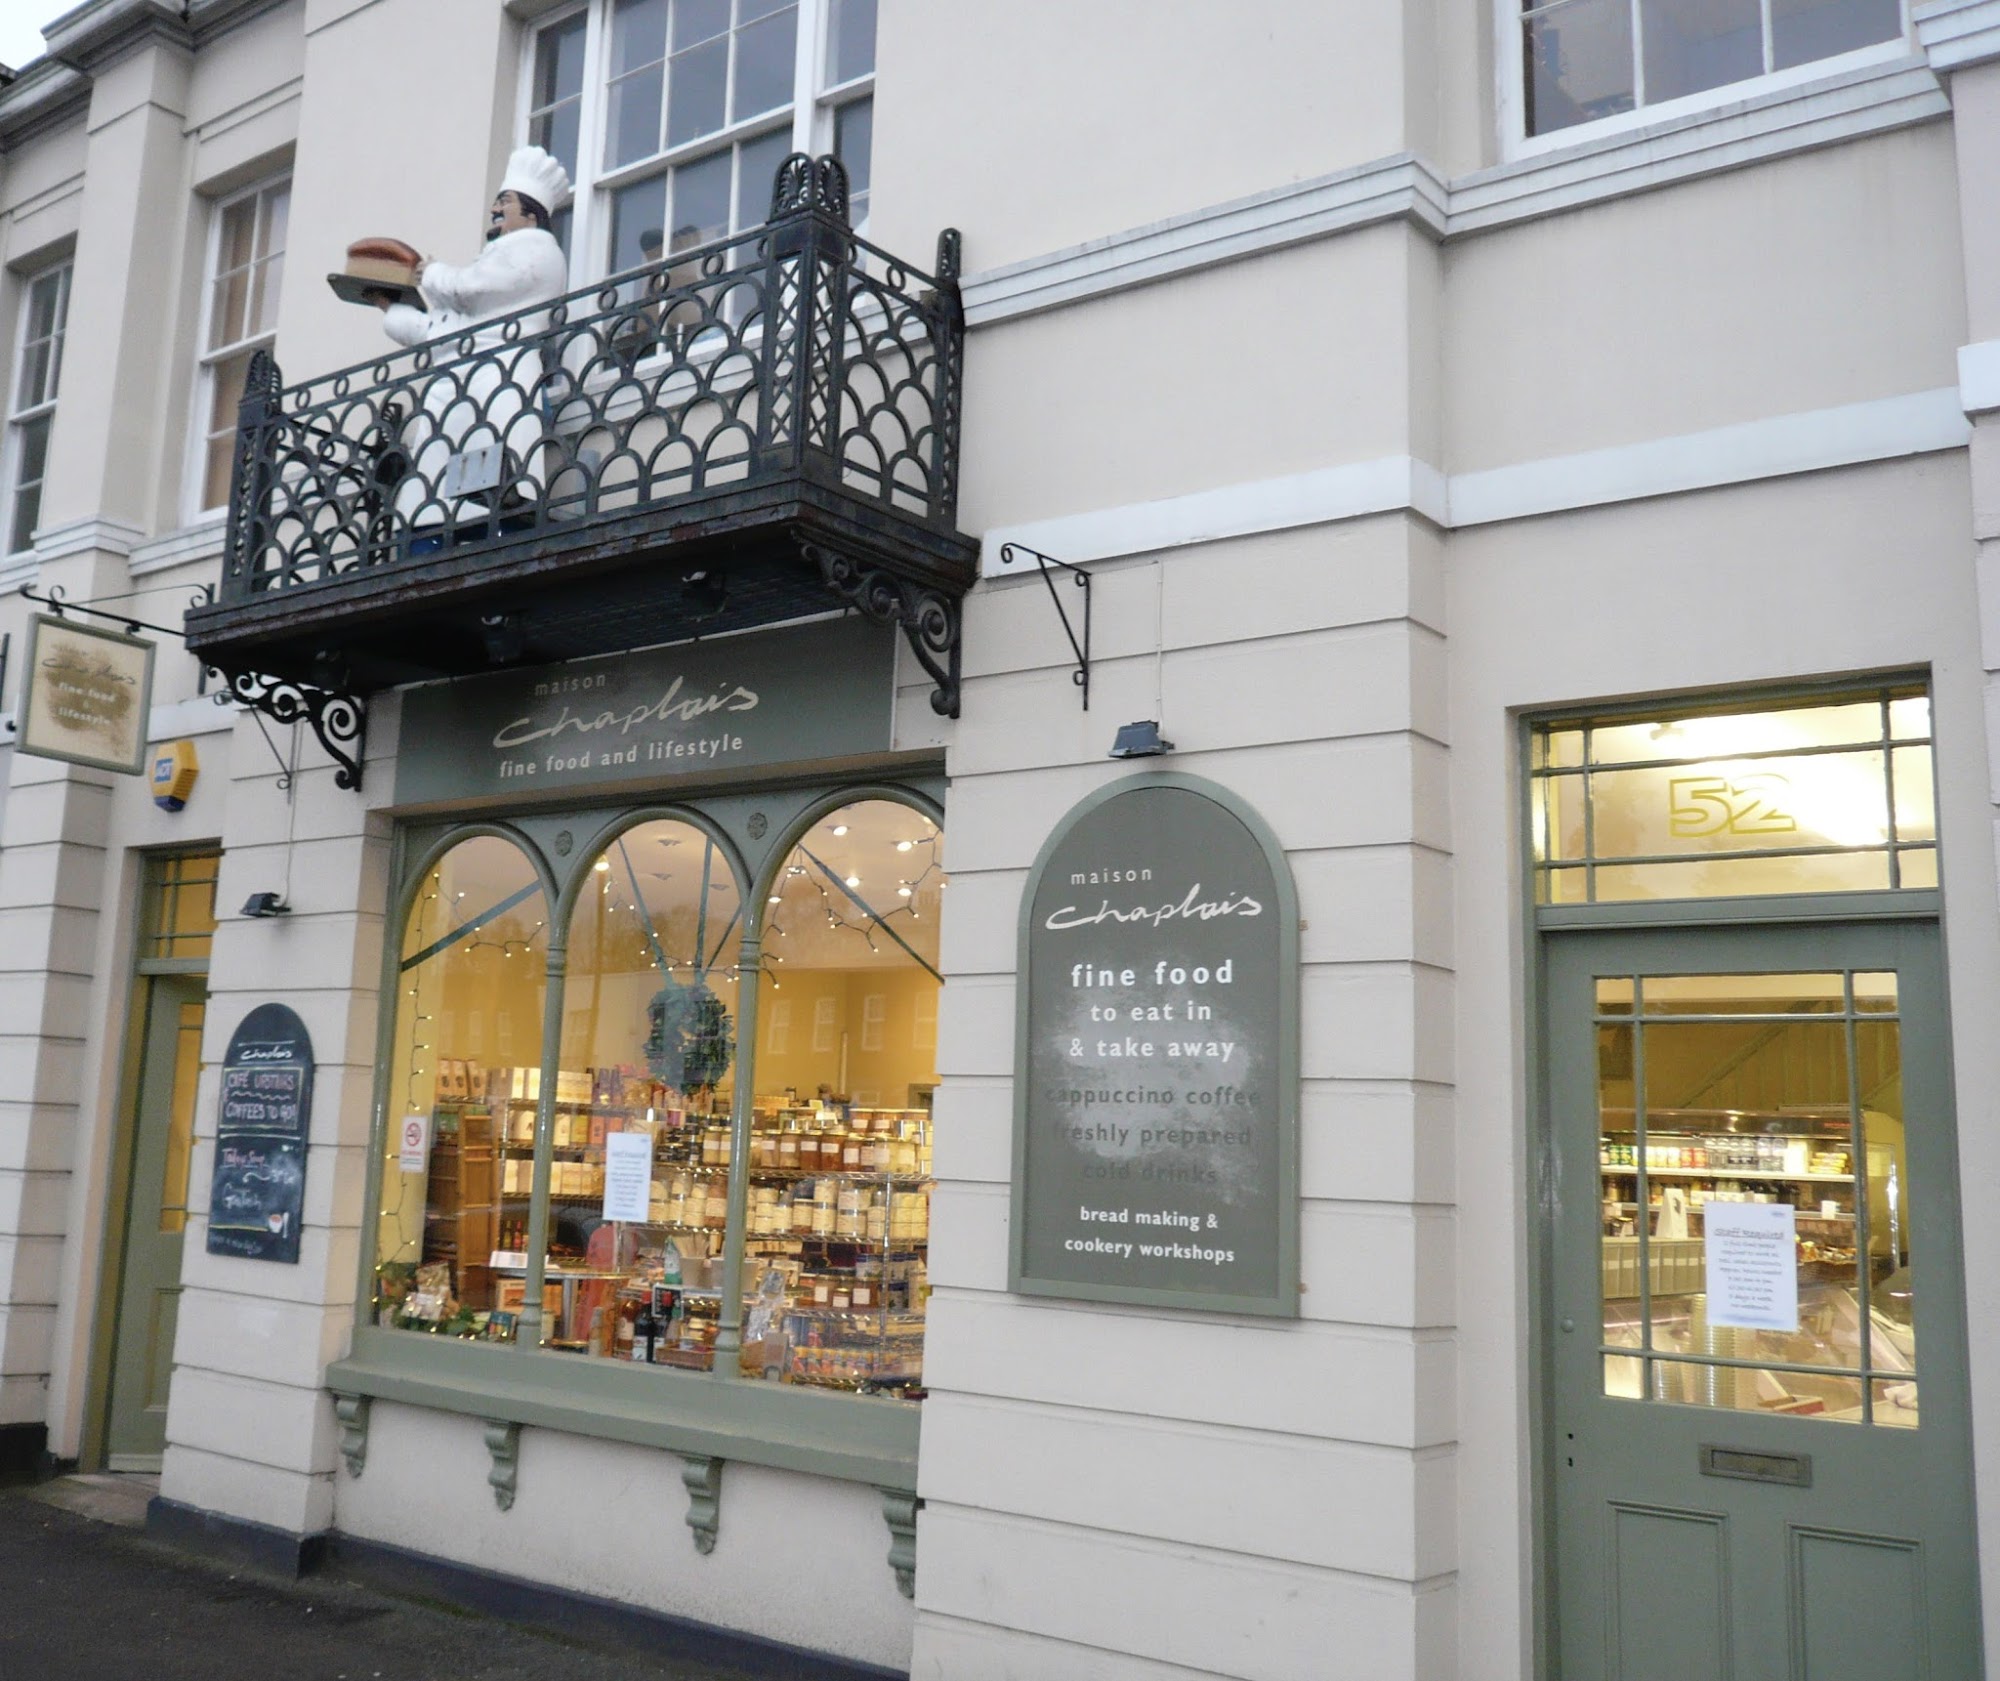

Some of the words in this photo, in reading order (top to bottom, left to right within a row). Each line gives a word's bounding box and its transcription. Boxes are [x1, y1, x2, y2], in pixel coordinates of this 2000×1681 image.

[534, 674, 606, 697] maison
[500, 760, 537, 778] fine
[546, 752, 591, 772] food
[601, 746, 637, 766] and
[649, 733, 743, 760] lifestyle
[1669, 776, 1797, 838] 52
[1070, 868, 1152, 885] maison
[1071, 964, 1136, 988] fine
[1154, 959, 1233, 986] food
[1090, 1004, 1117, 1022] to
[1130, 1004, 1174, 1022] eat
[1187, 1000, 1211, 1021] in
[1069, 1038, 1084, 1057] &
[1097, 1038, 1154, 1057] take
[1167, 1042, 1235, 1063] away
[1080, 1206, 1128, 1223] bread
[1135, 1210, 1200, 1232] making
[1206, 1213, 1219, 1229] &
[1064, 1238, 1133, 1258] cookery
[1139, 1243, 1235, 1265] workshops
